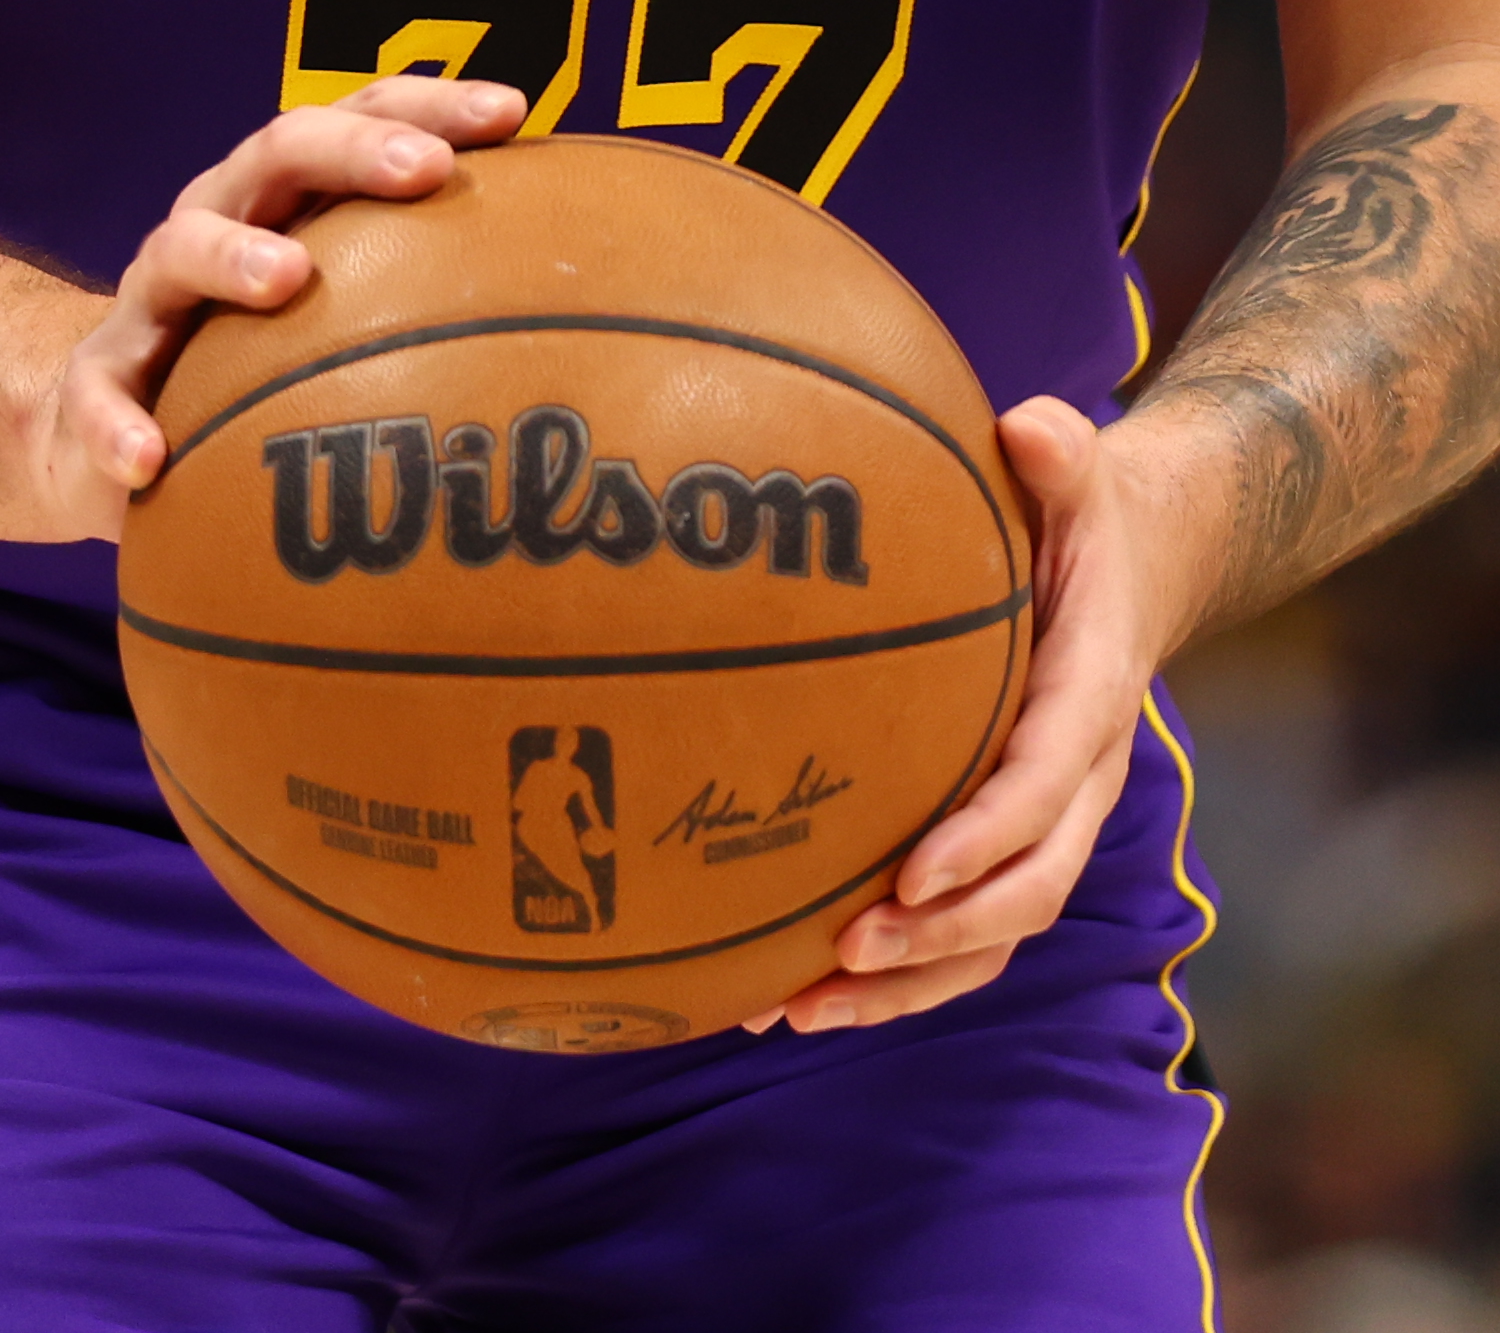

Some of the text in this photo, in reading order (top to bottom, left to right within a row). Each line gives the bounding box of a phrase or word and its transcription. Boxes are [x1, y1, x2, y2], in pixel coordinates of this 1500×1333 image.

[262, 404, 869, 587] Wilson
[427, 808, 476, 846] BALL
[524, 895, 577, 925] NBA
